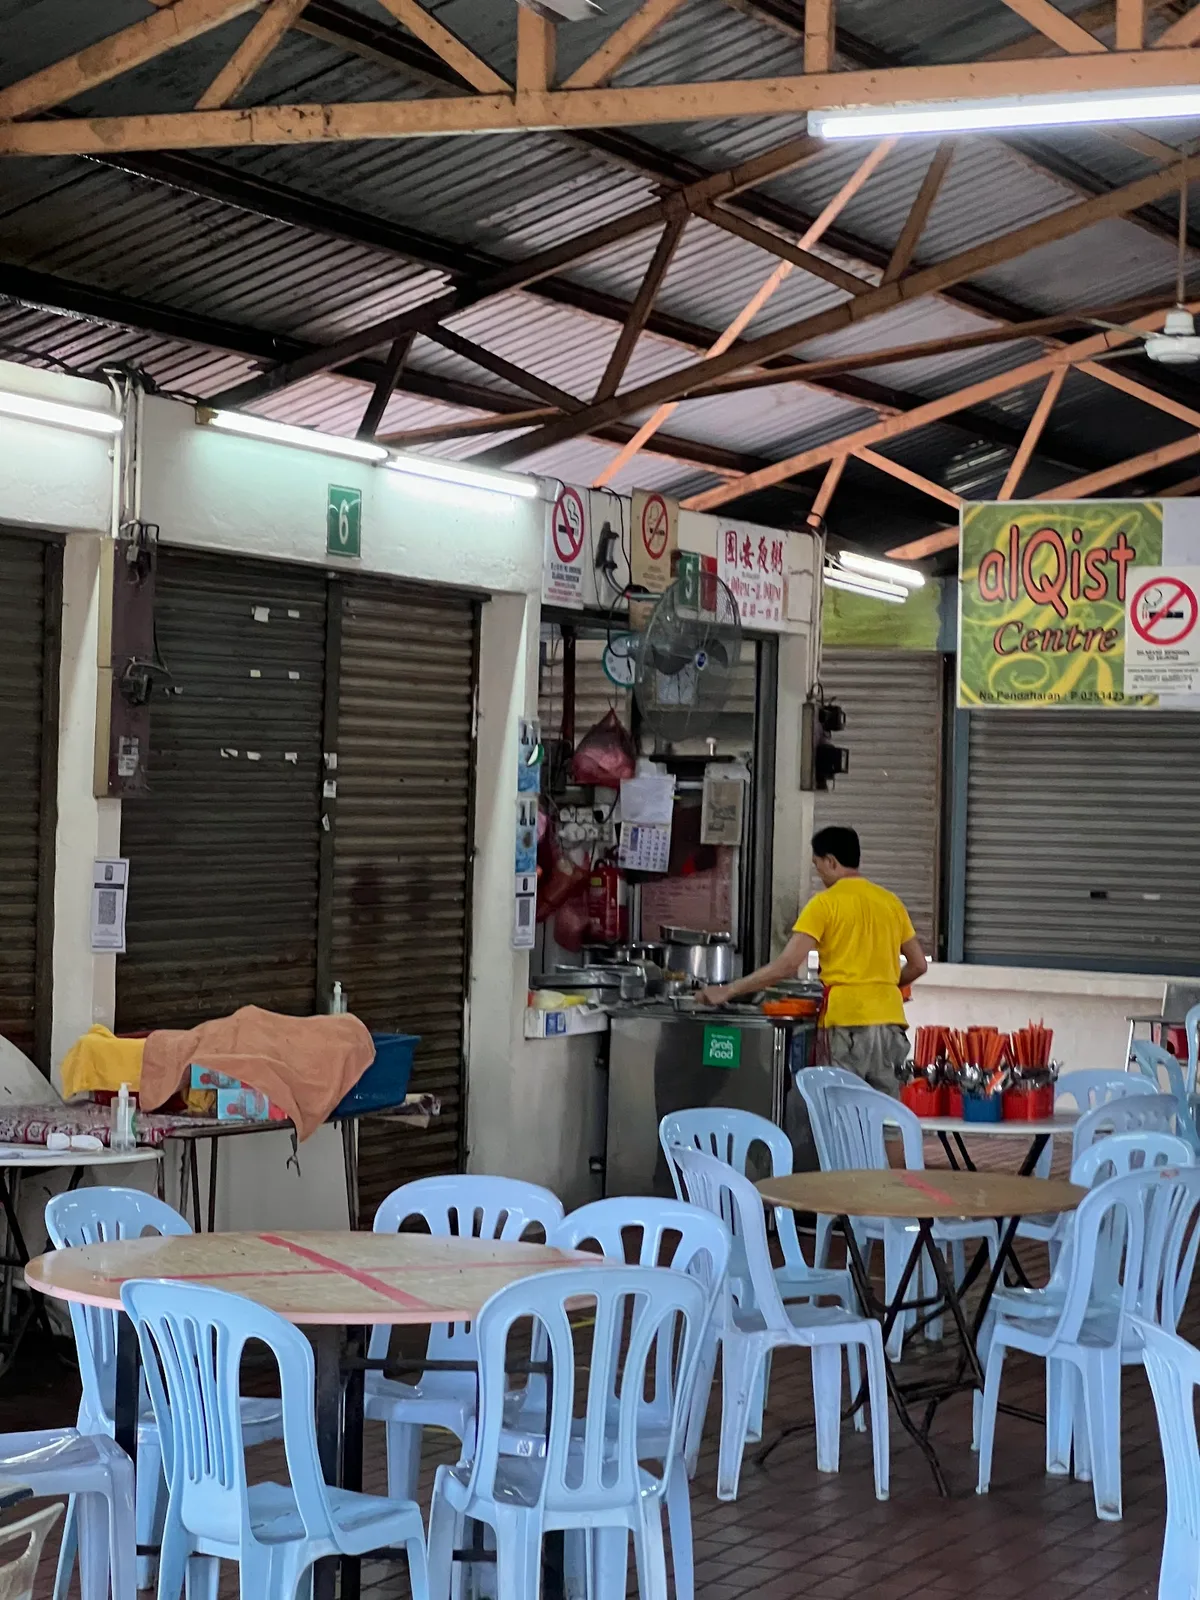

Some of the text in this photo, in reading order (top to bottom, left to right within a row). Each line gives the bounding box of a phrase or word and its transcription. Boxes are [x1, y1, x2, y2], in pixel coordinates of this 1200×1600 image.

[339, 499, 349, 545] 6
[682, 559, 693, 599] 5
[978, 524, 1136, 619] alQist
[993, 620, 1118, 655] Centre
[711, 1039, 733, 1050] Grab
